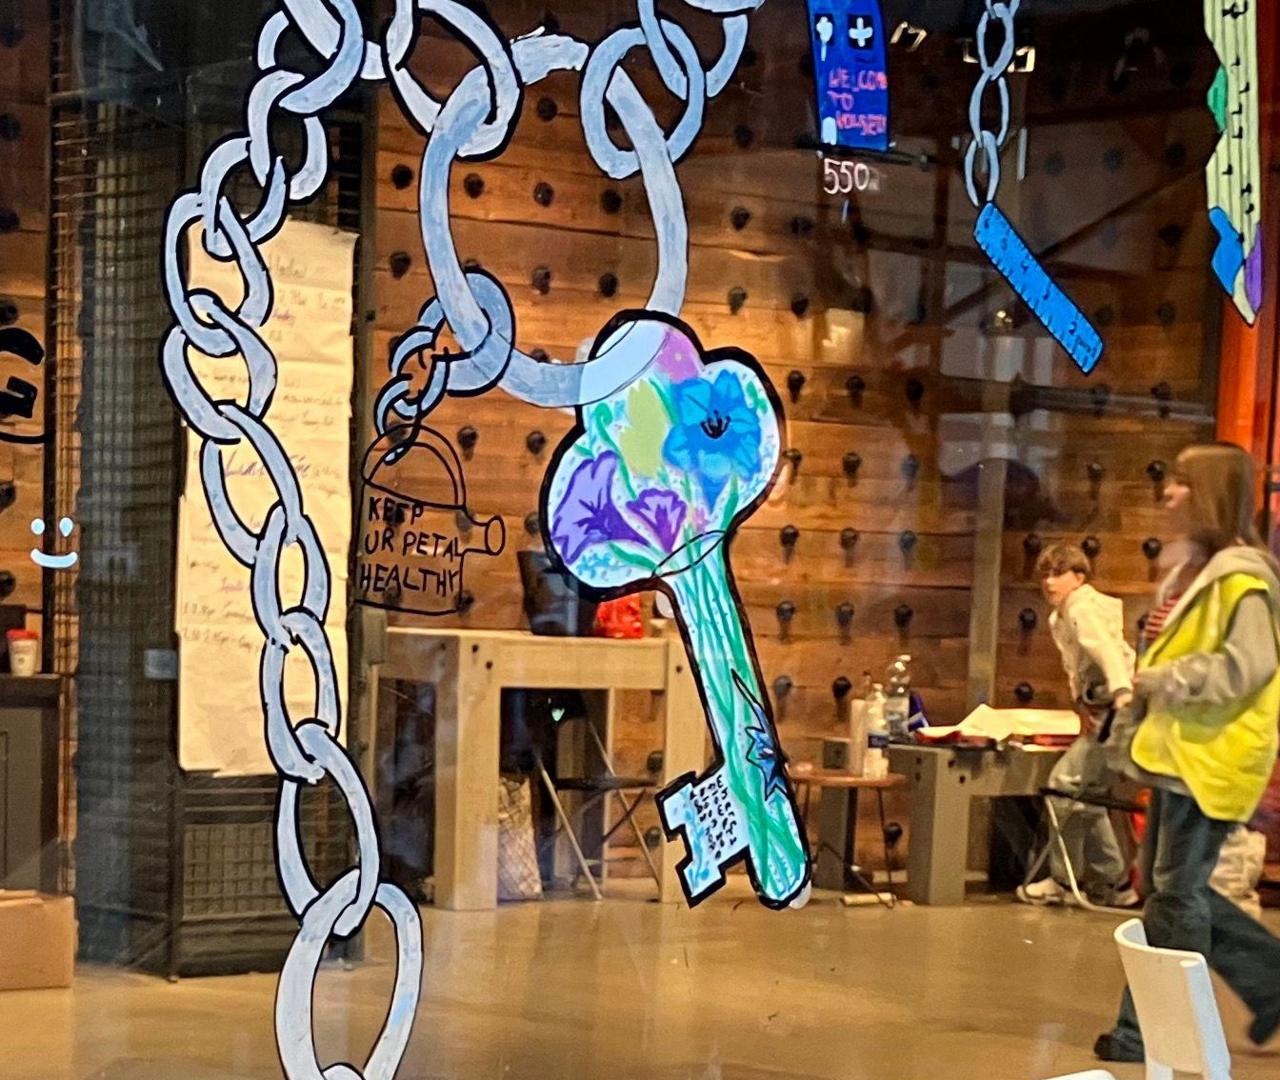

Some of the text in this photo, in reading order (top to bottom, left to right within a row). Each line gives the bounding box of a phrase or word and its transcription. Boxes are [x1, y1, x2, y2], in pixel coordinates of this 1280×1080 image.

[823, 158, 870, 195] 550
[368, 496, 425, 526] KEEP
[364, 527, 464, 562] UR PETAL
[359, 563, 460, 598] HEALTHY
